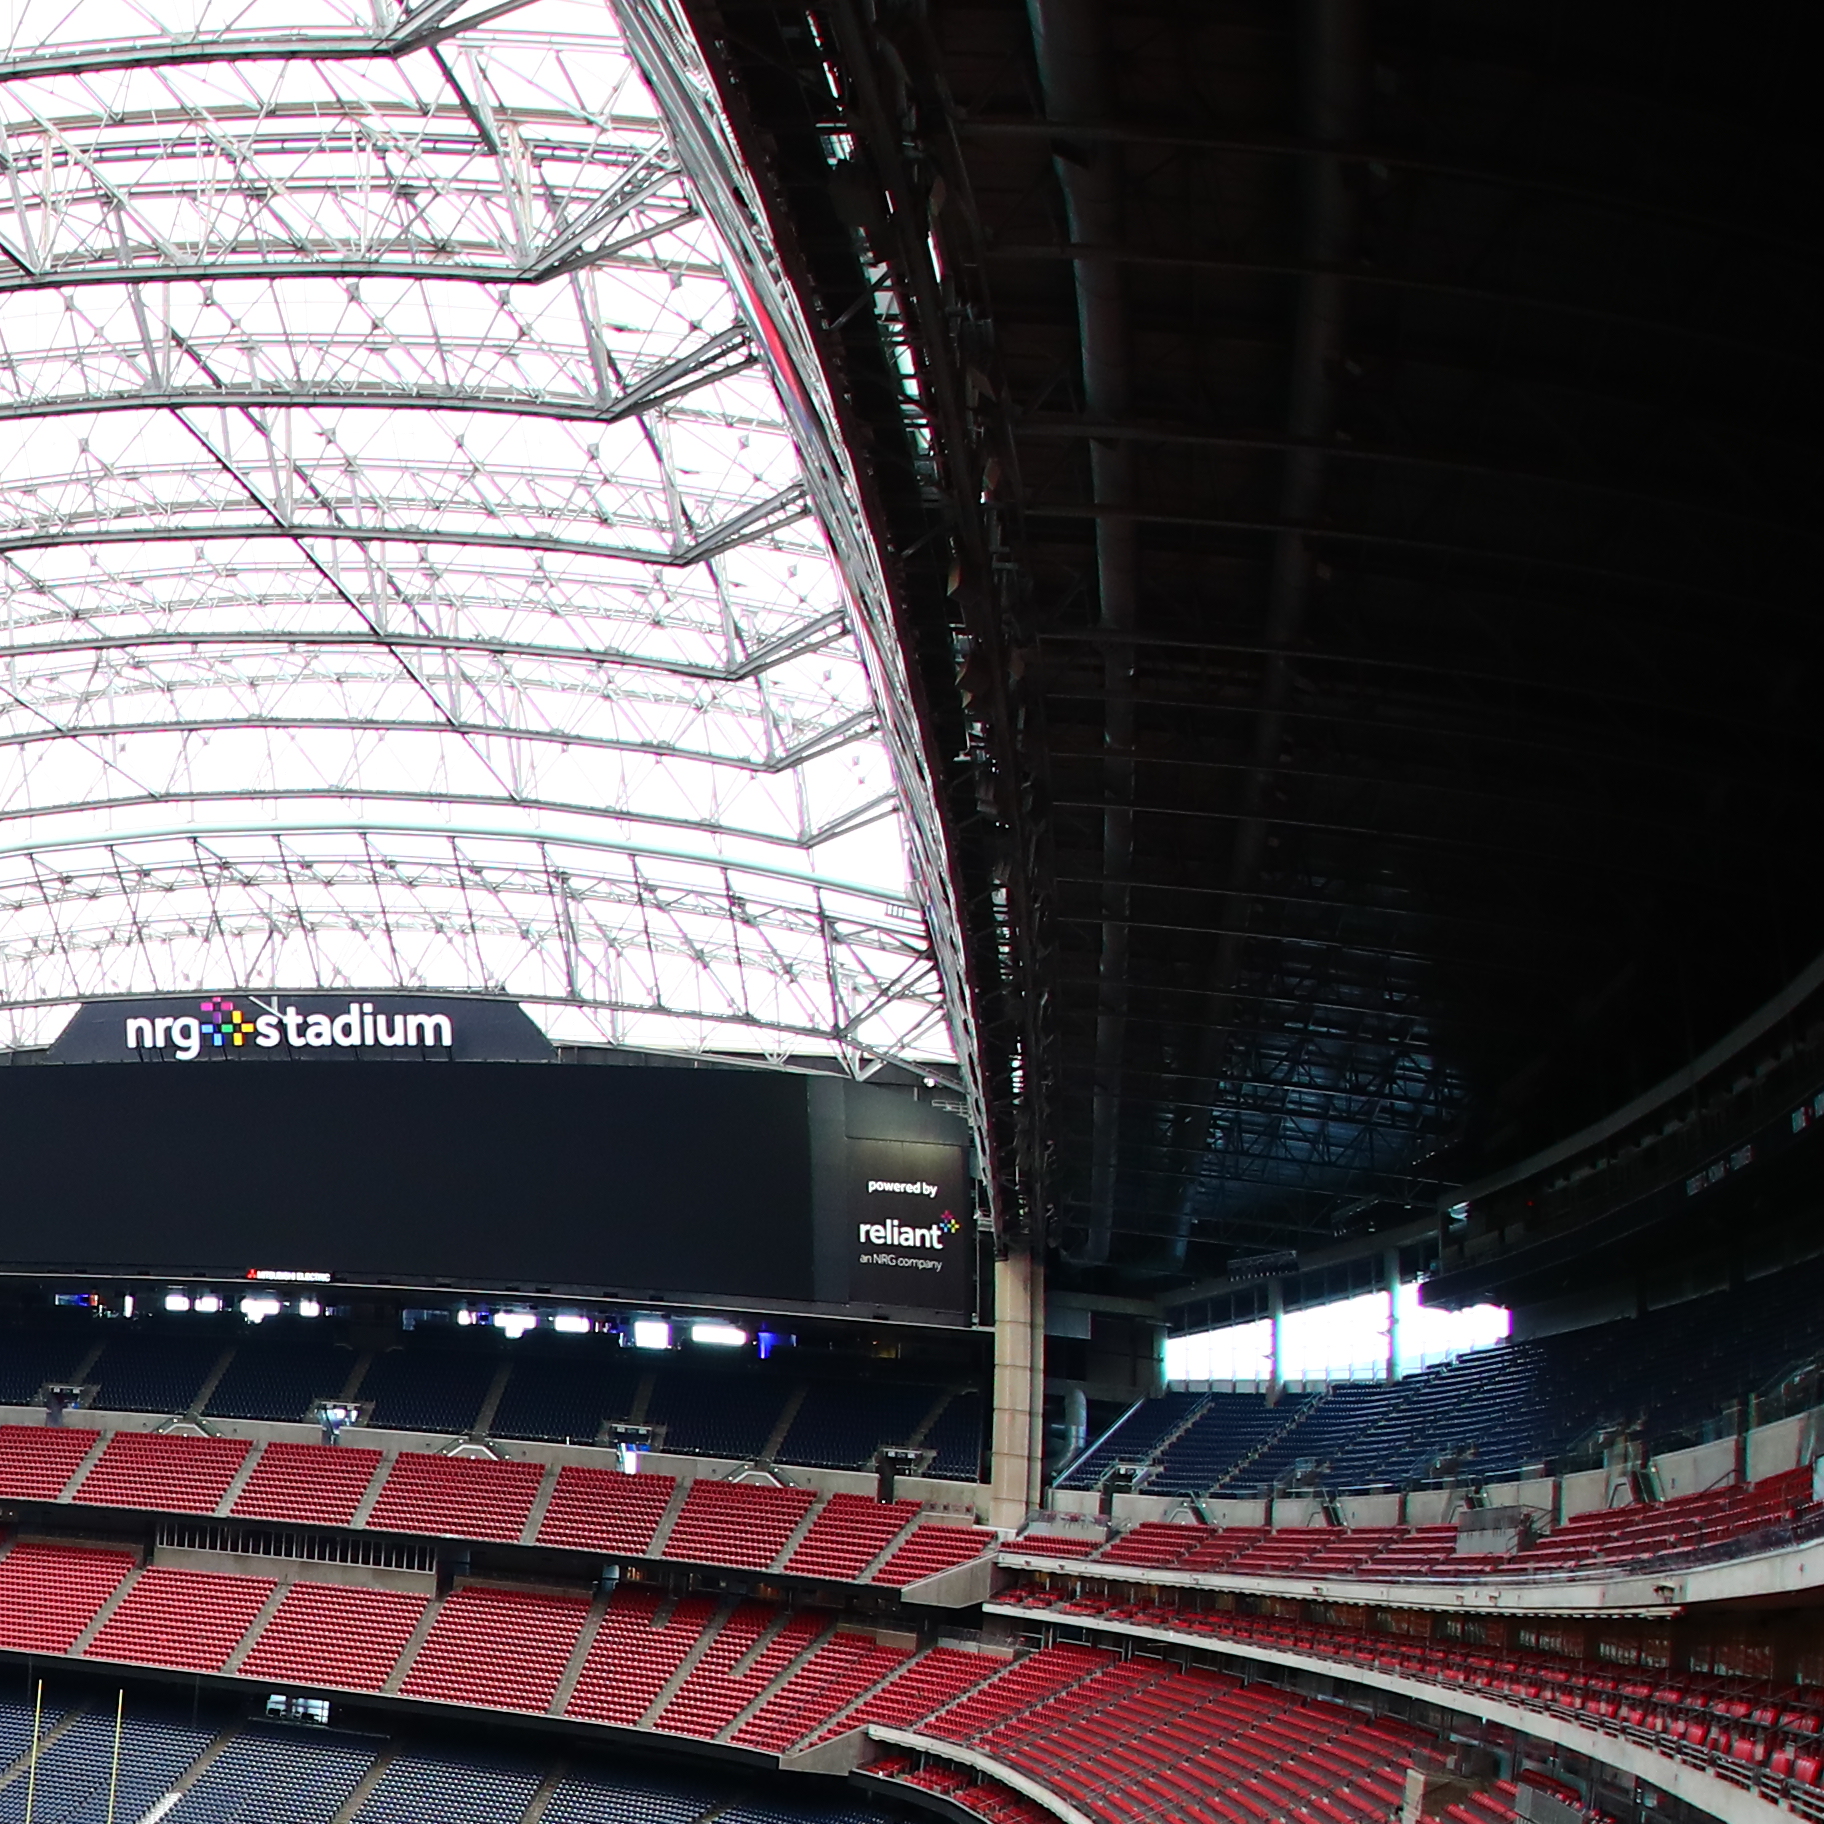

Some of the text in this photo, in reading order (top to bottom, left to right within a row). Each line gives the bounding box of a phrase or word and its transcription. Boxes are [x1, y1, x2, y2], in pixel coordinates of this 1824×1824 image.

[126, 1003, 452, 1061] nrg stadium
[868, 1181, 938, 1198] powered by
[859, 1219, 944, 1249] reliant
[859, 1254, 943, 1272] an NRG company
